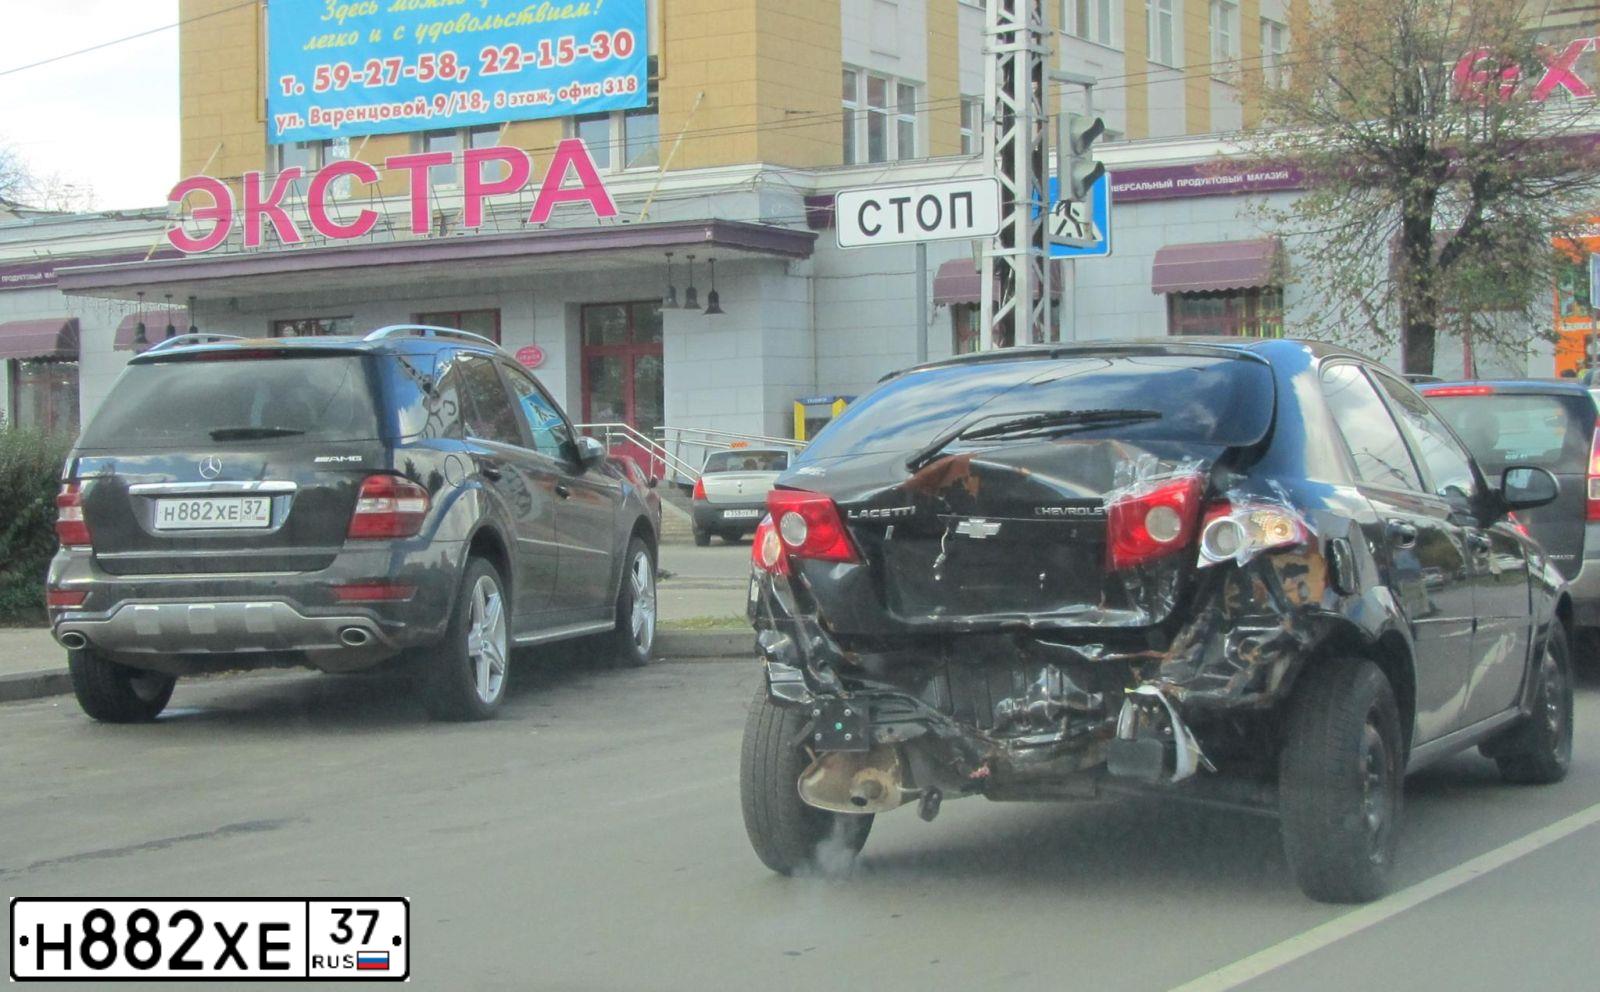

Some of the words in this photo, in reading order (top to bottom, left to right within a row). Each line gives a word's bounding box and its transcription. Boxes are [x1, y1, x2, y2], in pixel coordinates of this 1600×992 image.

[304, 31, 360, 50] легко
[369, 29, 382, 42] и
[393, 26, 405, 40] с
[415, 1, 602, 44] удовольствием!
[321, 0, 378, 25] Здесь
[281, 76, 305, 96] т.
[313, 51, 470, 95] 59-27-58,
[480, 29, 635, 76] 22-15-30
[275, 113, 304, 135] ул.
[494, 91, 507, 108] 3
[509, 91, 554, 107] этаж,
[557, 83, 600, 103] офис
[603, 76, 637, 95] 318
[166, 138, 619, 254] ЭКСТРА
[1177, 175, 1242, 187] ПРОДУКТОВЫЙ
[1247, 171, 1289, 181] МАГАЗИН
[858, 191, 973, 237] СТОП
[164, 501, 239, 520] Н882ХЕ
[243, 500, 262, 515] 37
[848, 506, 915, 519] LACETTI
